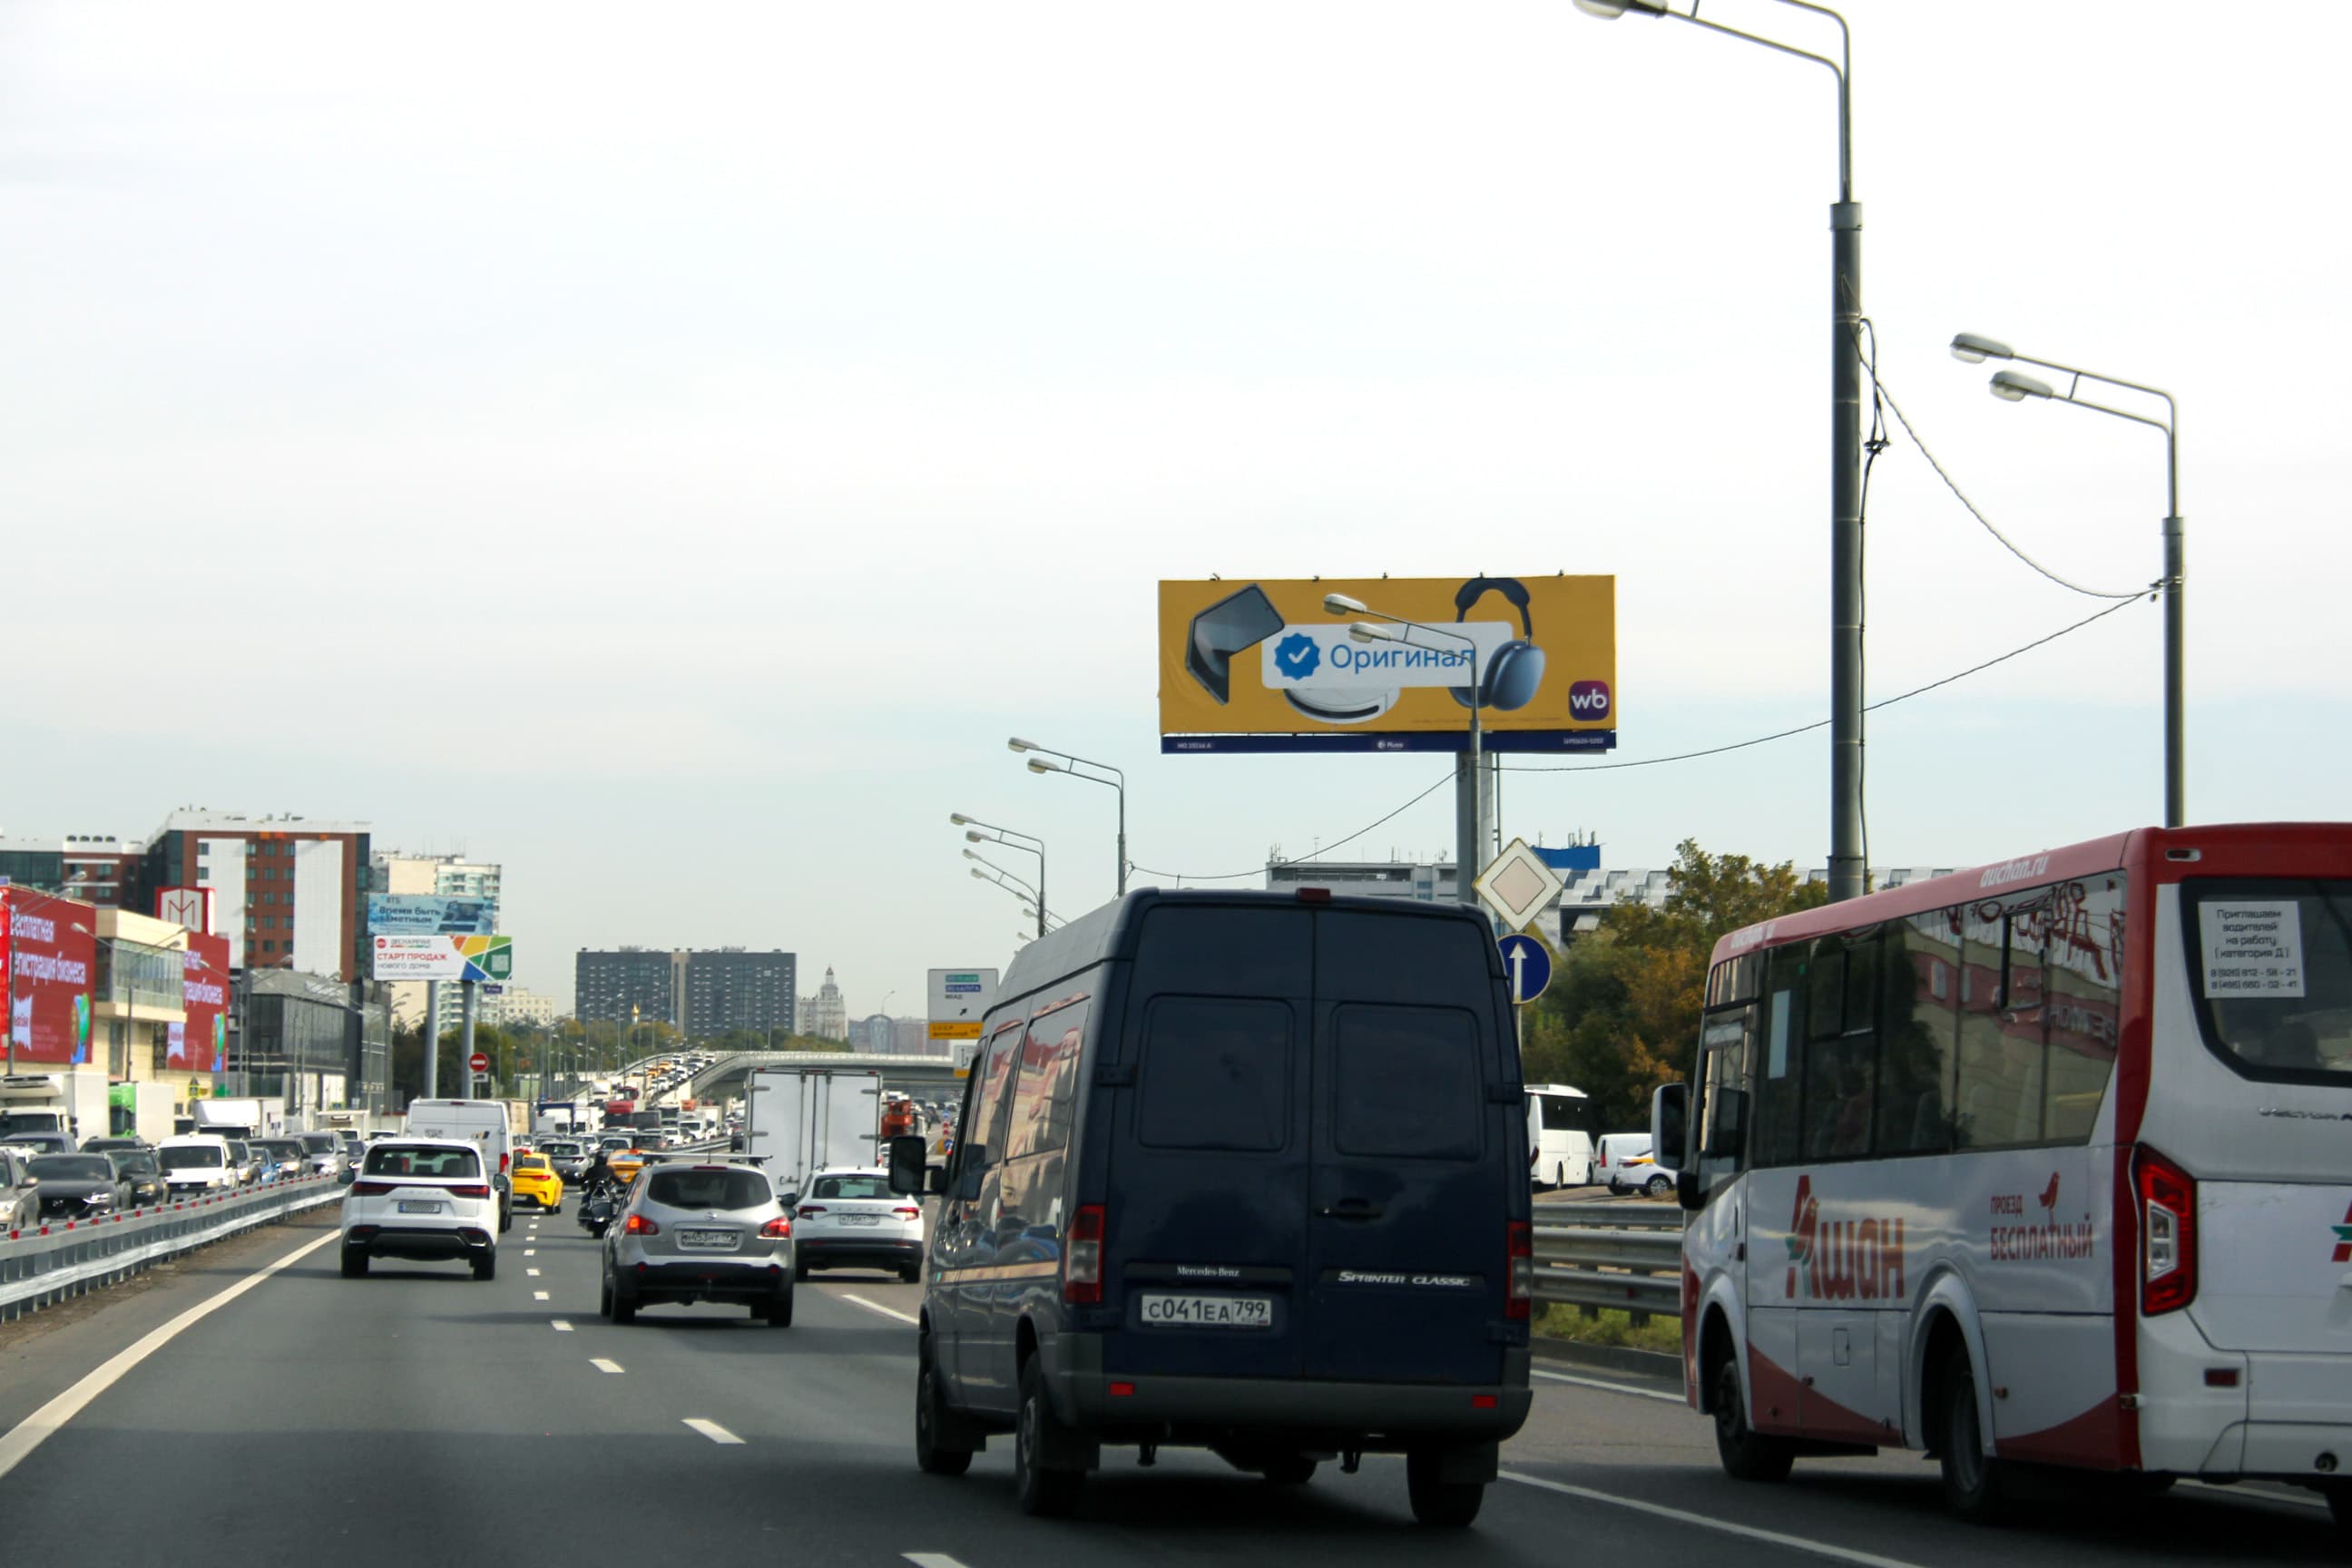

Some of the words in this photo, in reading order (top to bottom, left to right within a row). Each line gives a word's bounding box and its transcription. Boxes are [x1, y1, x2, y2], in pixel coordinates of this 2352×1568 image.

[1330, 644, 1475, 673] Оригинал
[1572, 688, 1607, 709] wb
[1980, 856, 2048, 887] auchan.ru
[415, 906, 441, 916] быть
[2217, 909, 2281, 919] Приглашаем
[2222, 922, 2277, 932] водителей
[2240, 936, 2277, 946] работу
[377, 953, 405, 961] СТАРТ
[407, 953, 447, 962] ПРОДАЖ
[2220, 949, 2272, 959] категория
[9, 951, 56, 985] егистрация
[1991, 1195, 2023, 1217] ПРОЕЗД
[1991, 1213, 2092, 1260] БЕСПЛАТНЫЙ
[1177, 1266, 1240, 1277] Mercedes-Benz
[1412, 1275, 1470, 1286] CLASSIC
